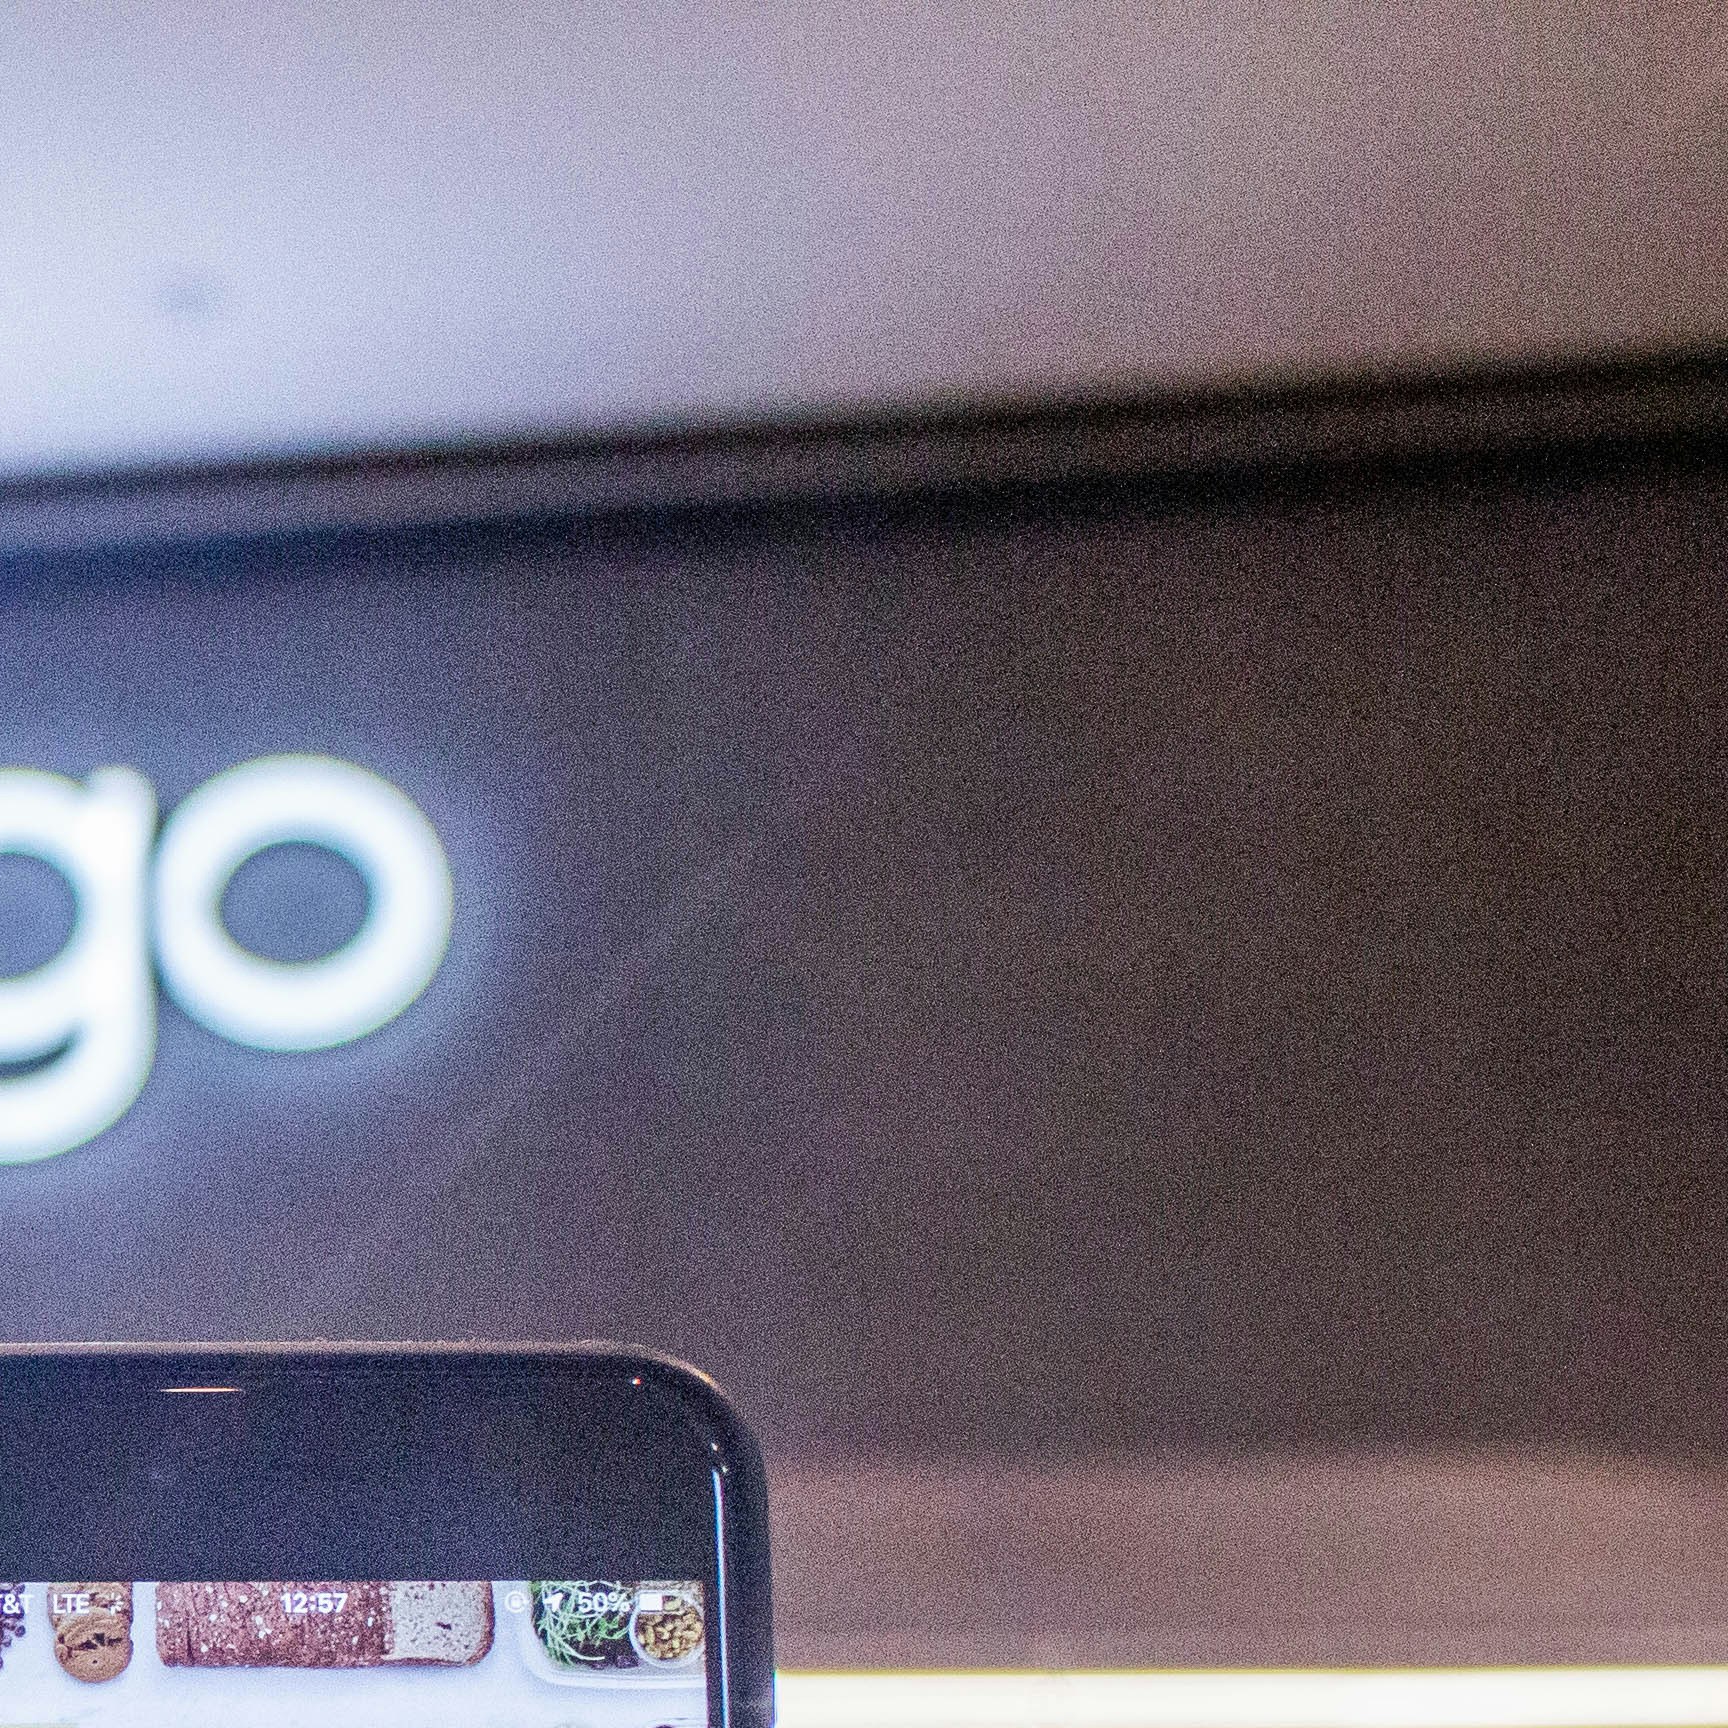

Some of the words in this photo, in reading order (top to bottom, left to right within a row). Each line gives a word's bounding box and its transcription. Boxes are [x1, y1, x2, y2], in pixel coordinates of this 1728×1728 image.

[53, 1593, 91, 1615] LTE
[280, 1591, 348, 1614] 12:57
[578, 1591, 631, 1613] 50%
